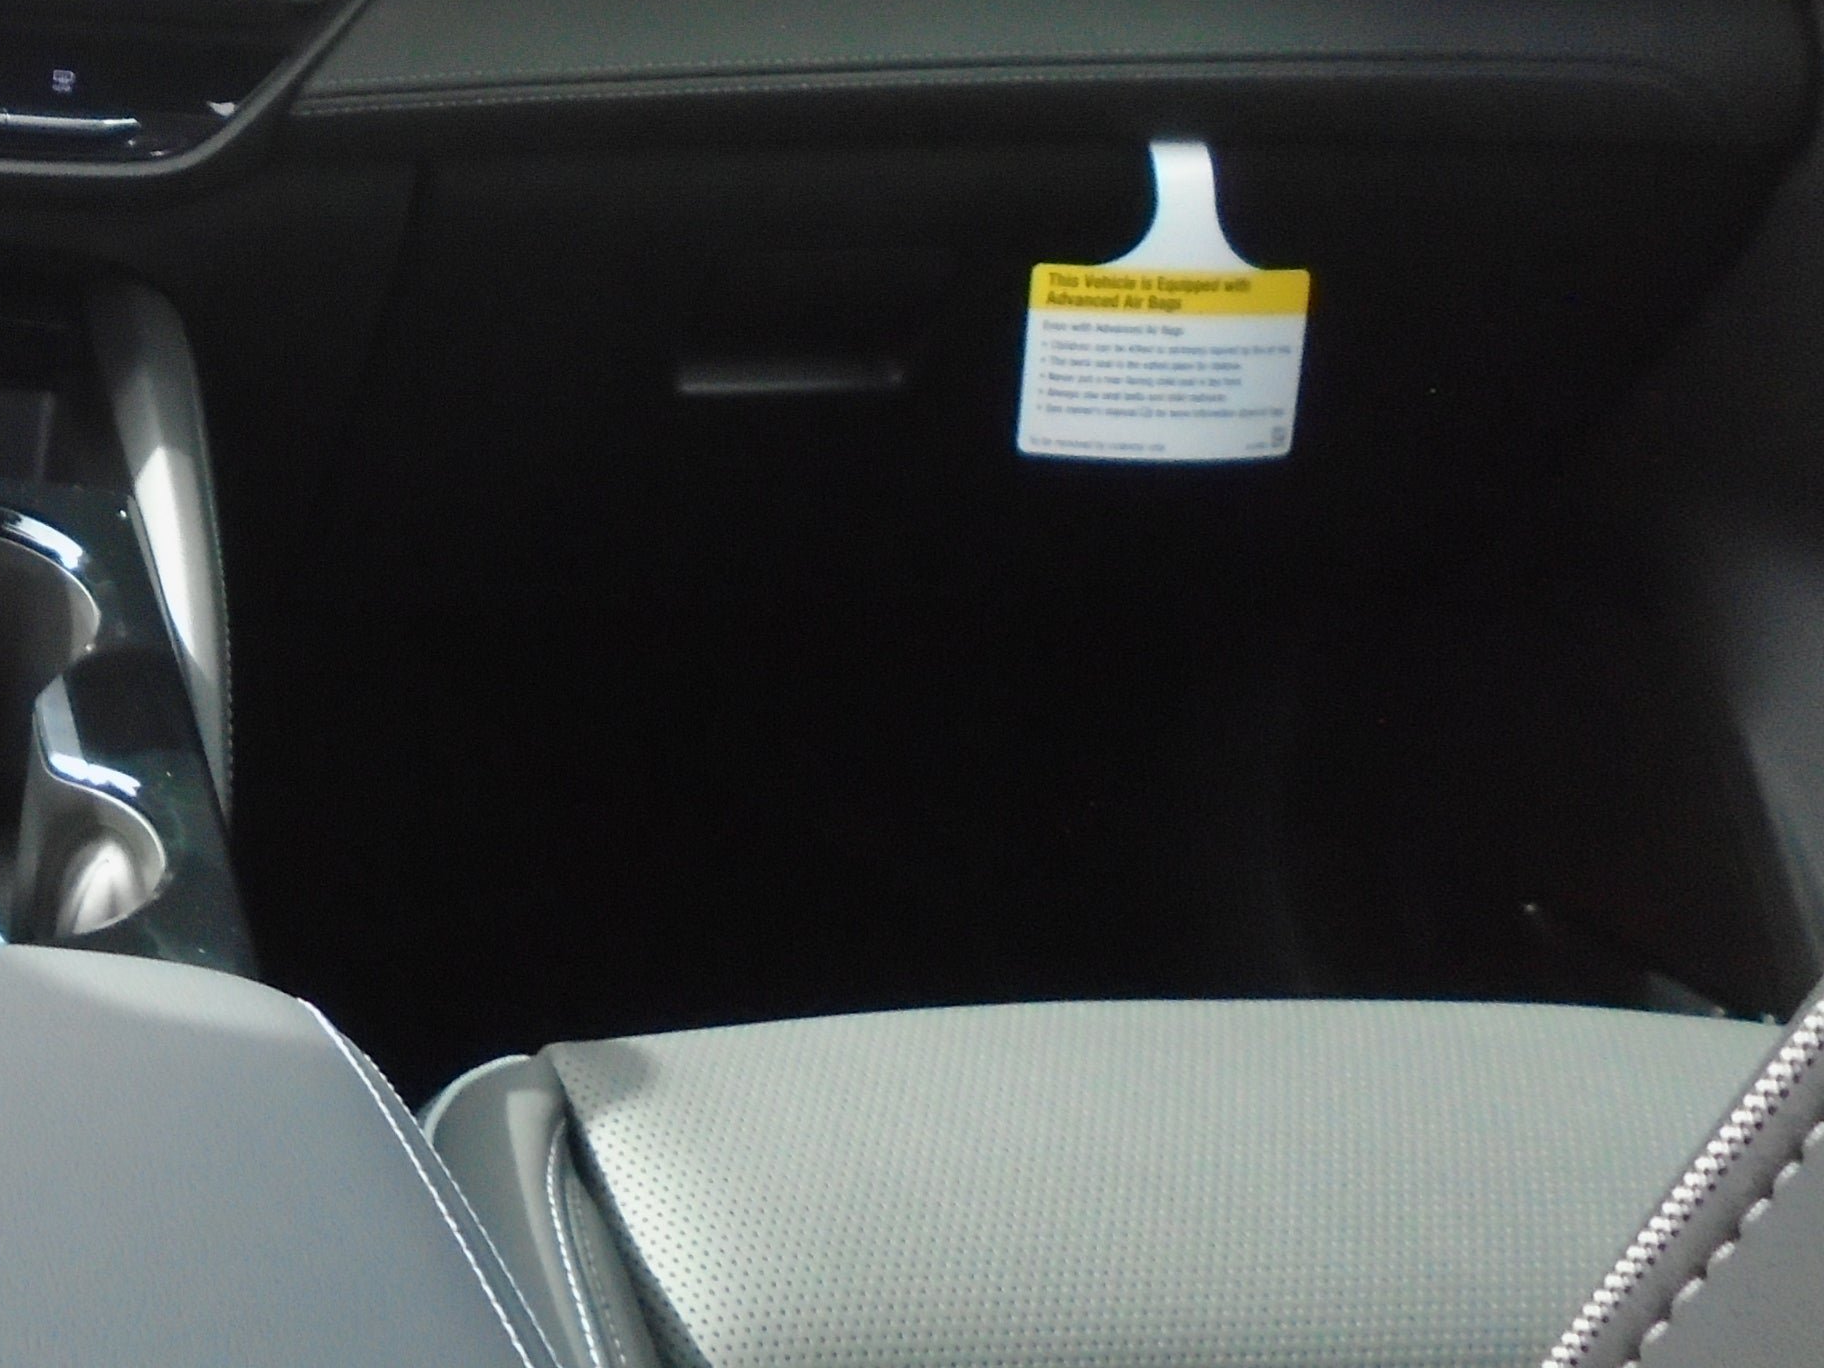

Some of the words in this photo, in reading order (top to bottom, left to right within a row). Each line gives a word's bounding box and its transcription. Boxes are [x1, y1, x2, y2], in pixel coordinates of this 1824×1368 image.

[1049, 272, 1079, 288] This
[1084, 273, 1136, 290] Vehicle
[1140, 276, 1153, 290] is
[1157, 276, 1219, 294] Equipped
[1224, 277, 1251, 292] with
[1046, 291, 1120, 309] Advanced
[1124, 293, 1144, 309] Air
[1148, 295, 1182, 313] Bags
